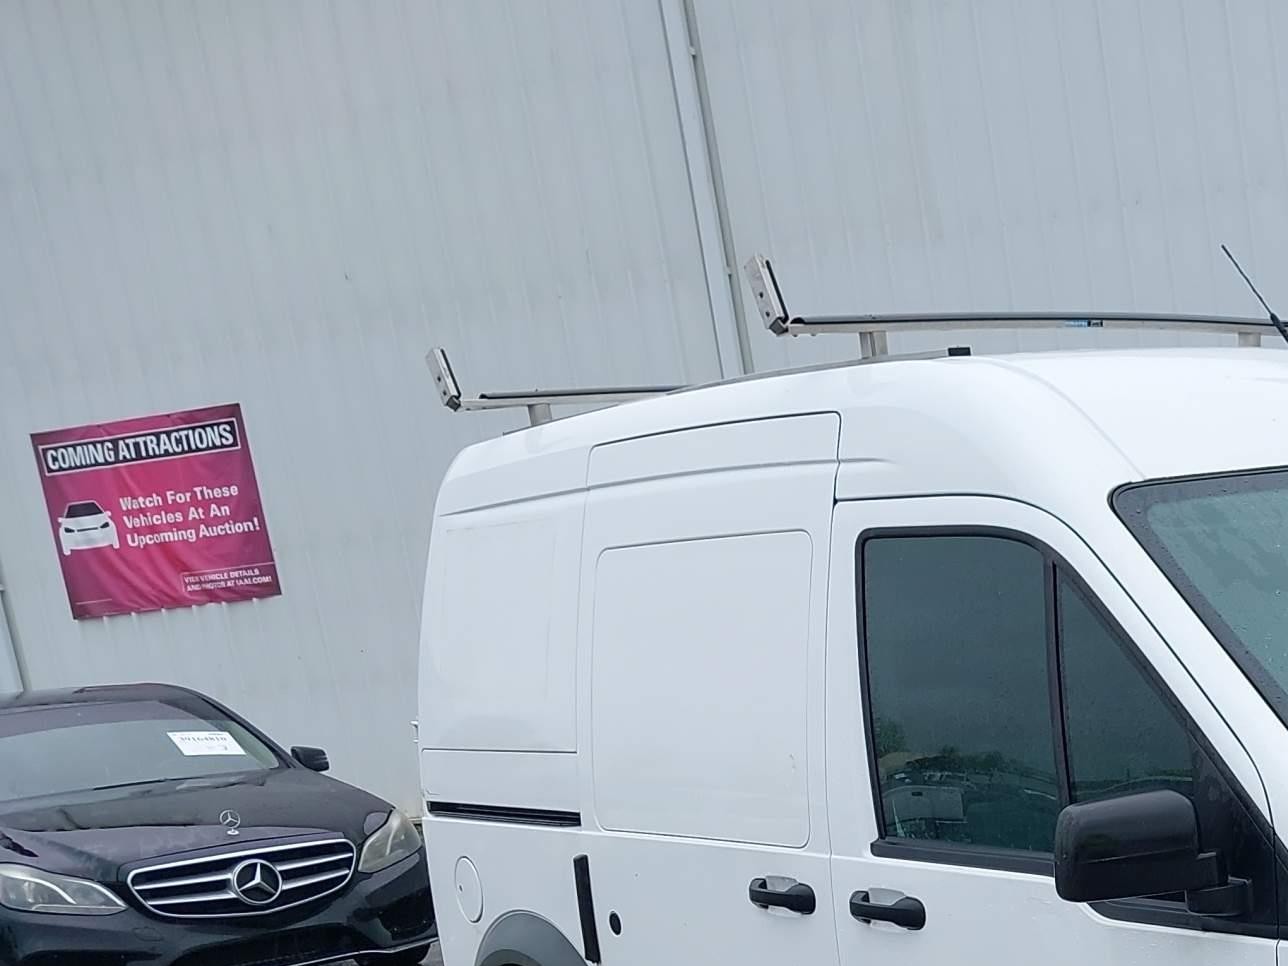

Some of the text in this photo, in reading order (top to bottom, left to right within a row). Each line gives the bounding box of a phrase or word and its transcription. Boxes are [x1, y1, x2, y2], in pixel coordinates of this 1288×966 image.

[46, 423, 234, 471] COMING ATTRACTIONS
[119, 483, 239, 511] Watch For These
[124, 503, 230, 529] Vehicles At An
[127, 517, 260, 548] Upcoming Auction!
